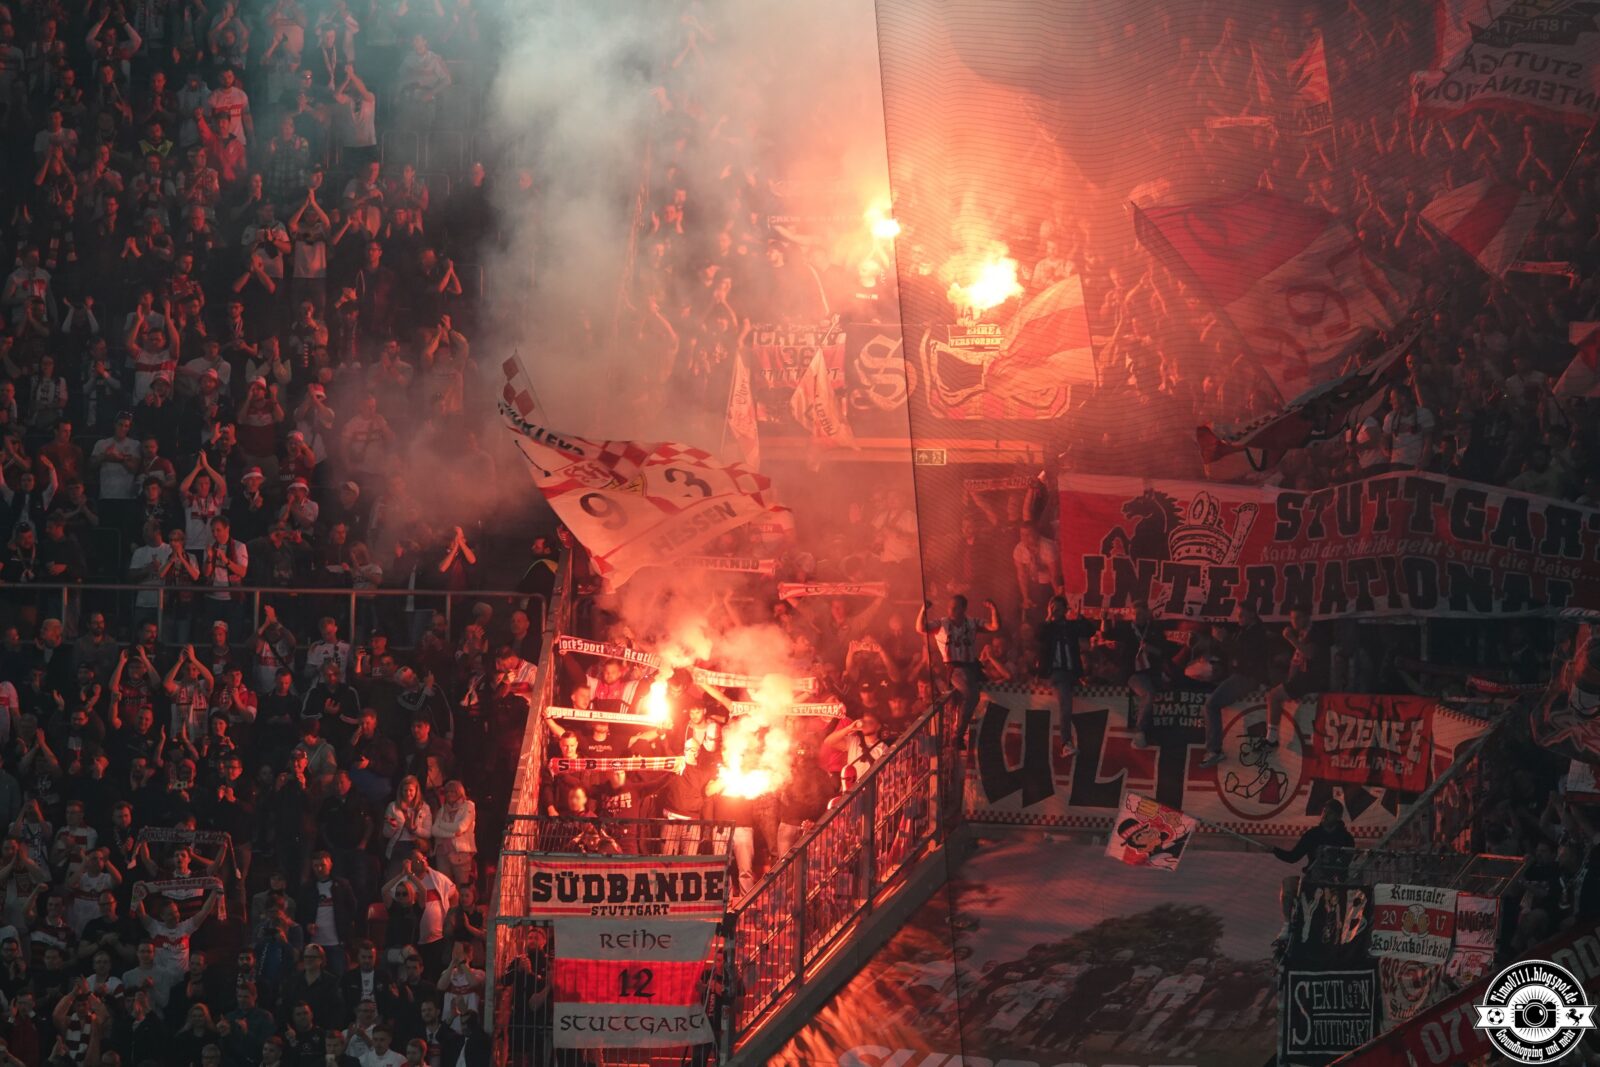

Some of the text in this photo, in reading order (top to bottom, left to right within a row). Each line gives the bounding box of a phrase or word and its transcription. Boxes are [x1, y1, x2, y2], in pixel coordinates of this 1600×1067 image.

[648, 500, 739, 557] HESSEN
[1274, 476, 1600, 561] STUTTGAR
[1300, 541, 1318, 559] all
[1462, 547, 1495, 566] auf
[1499, 552, 1527, 571] die
[532, 870, 723, 903] SÜDBANDE
[591, 904, 670, 916] STUTTGART
[1380, 909, 1397, 927] 20
[1435, 914, 1448, 934] 17
[618, 967, 657, 999] 12
